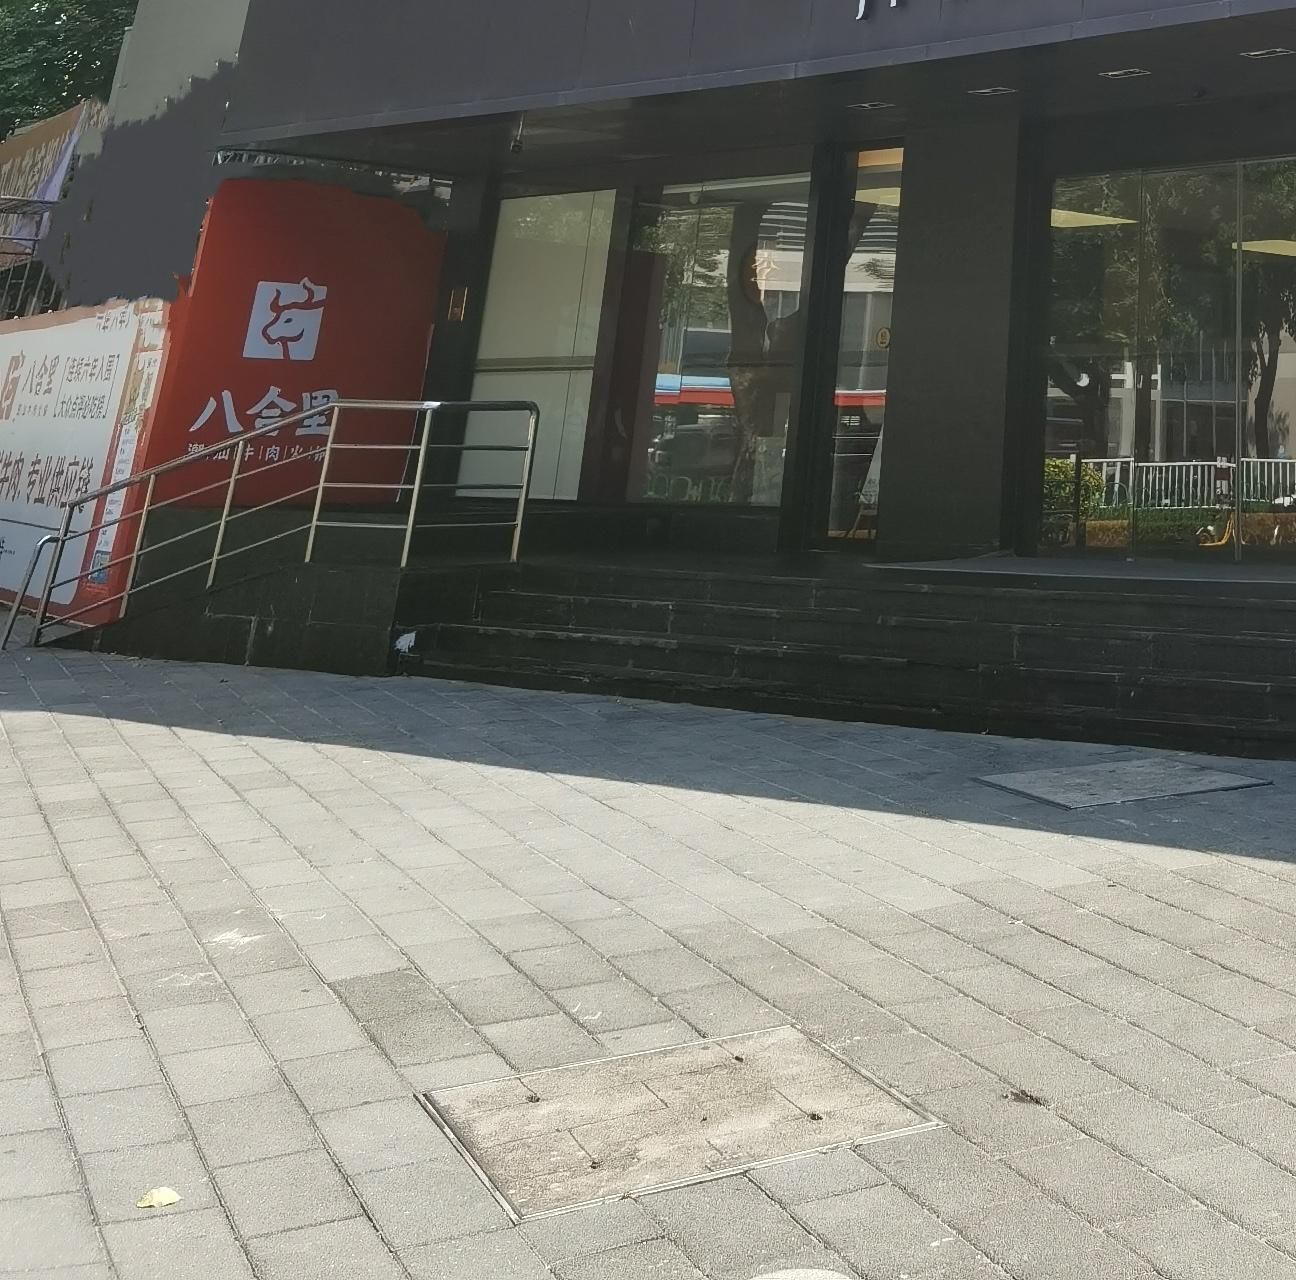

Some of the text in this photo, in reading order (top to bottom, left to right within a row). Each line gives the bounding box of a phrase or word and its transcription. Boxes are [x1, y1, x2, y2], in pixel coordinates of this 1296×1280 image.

[22, 354, 59, 396] 八合里
[188, 386, 339, 437] 八合里
